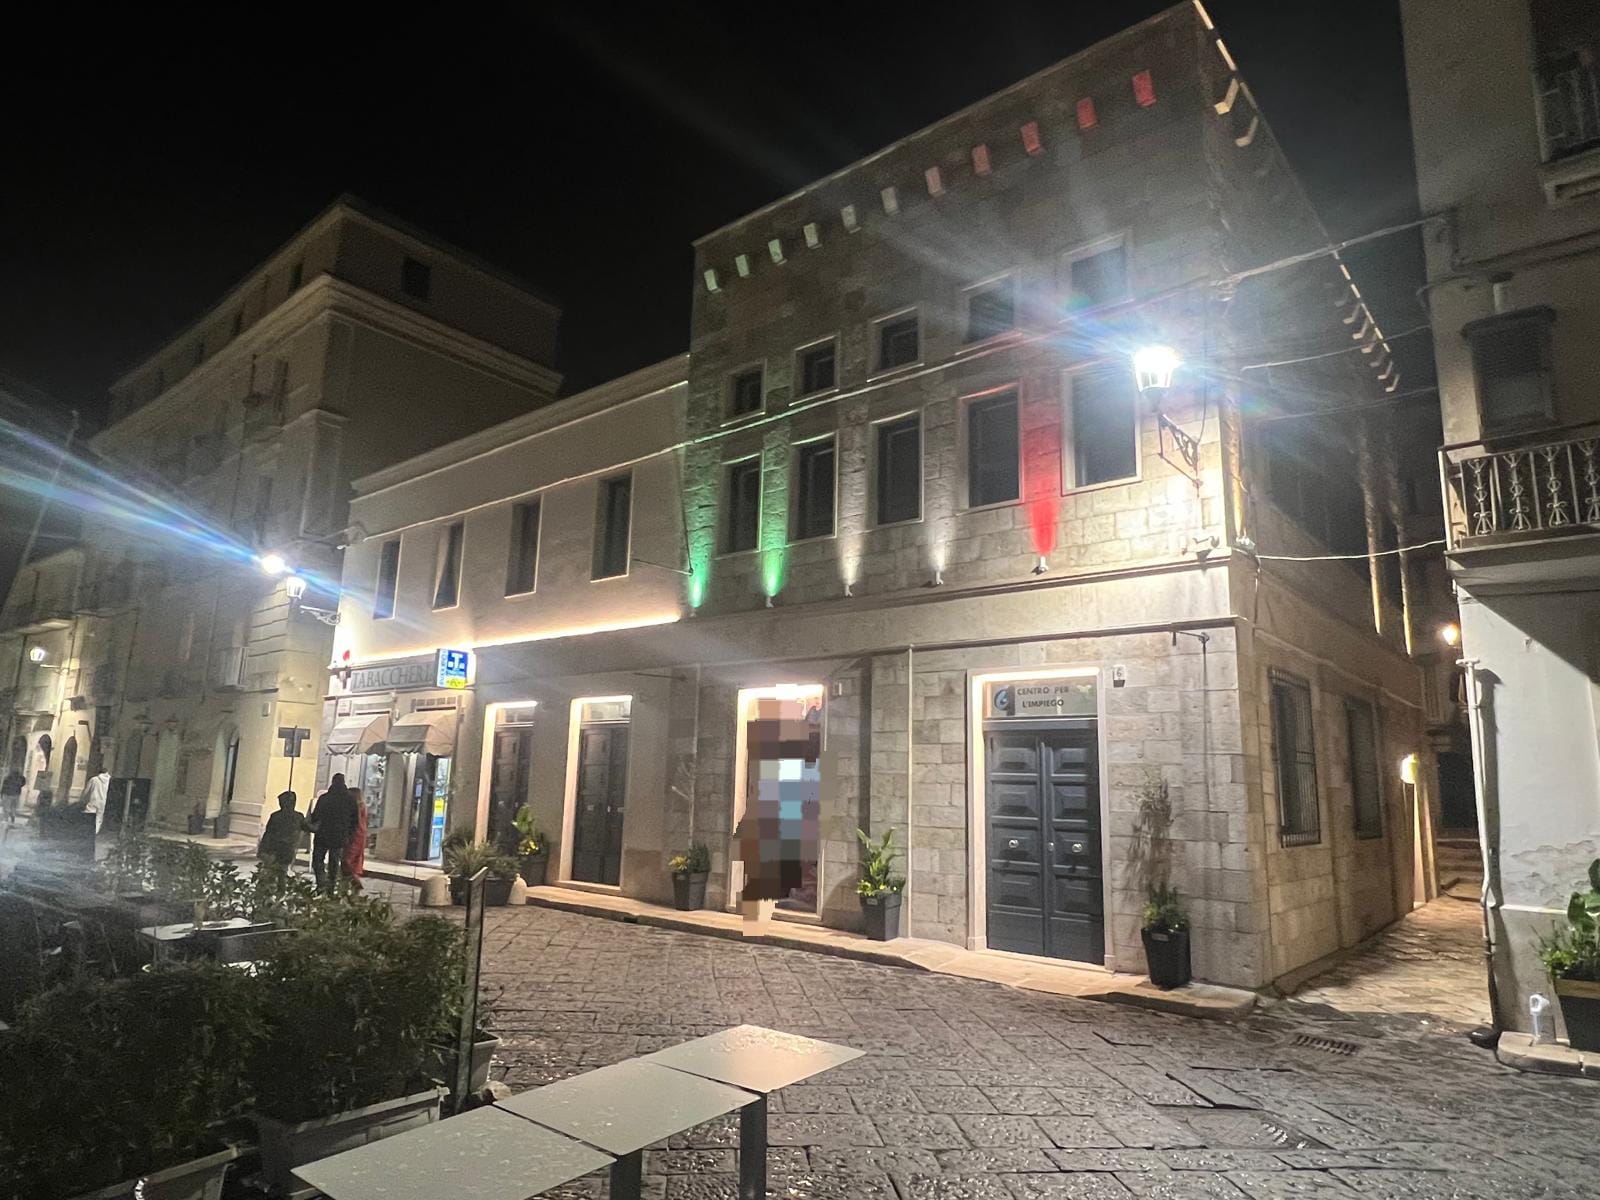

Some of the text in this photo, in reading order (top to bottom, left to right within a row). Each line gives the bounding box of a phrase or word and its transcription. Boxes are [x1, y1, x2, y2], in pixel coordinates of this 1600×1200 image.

[1017, 685, 1070, 696] CENTRO PER
[1022, 699, 1065, 709] L'IMPIEGO
